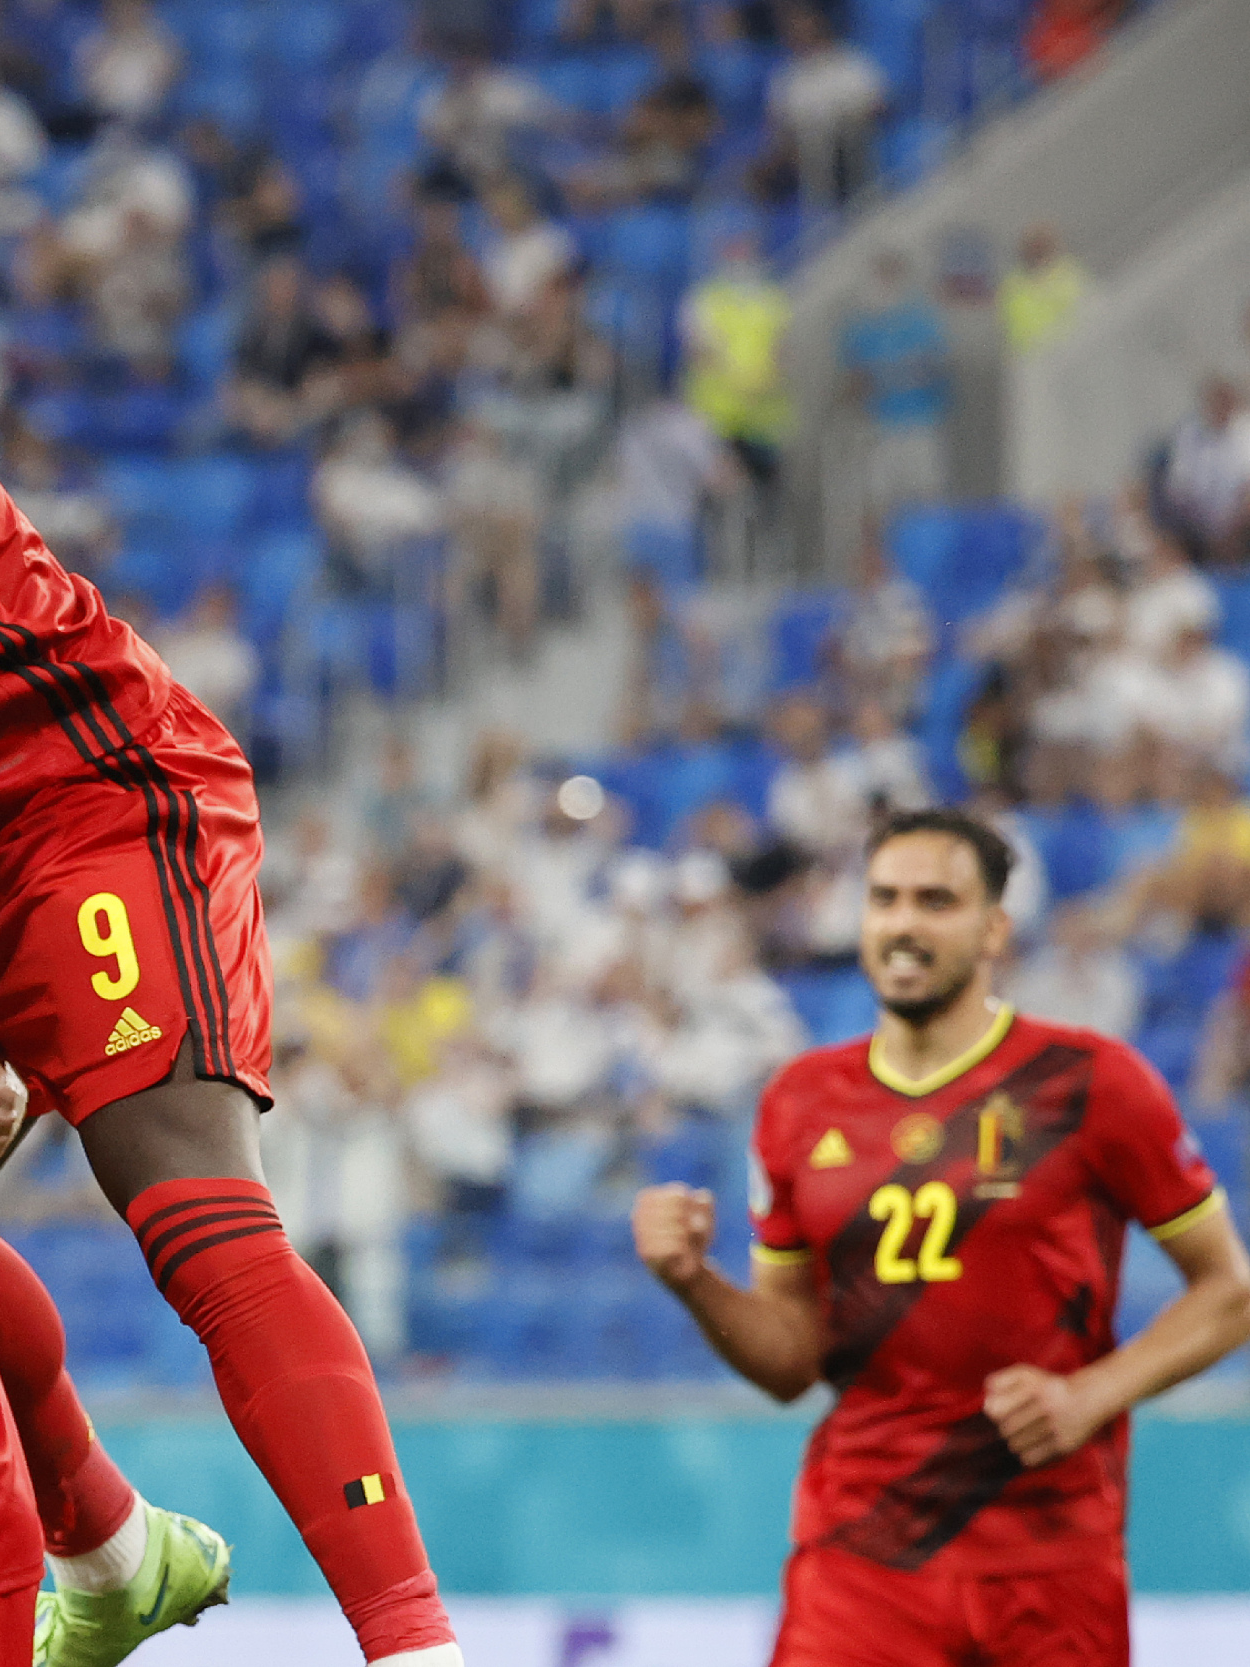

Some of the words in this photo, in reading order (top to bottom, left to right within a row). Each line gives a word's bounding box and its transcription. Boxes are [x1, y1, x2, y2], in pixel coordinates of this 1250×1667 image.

[77, 892, 140, 1001] 9
[104, 1026, 163, 1056] adidas
[868, 1181, 963, 1285] 22
